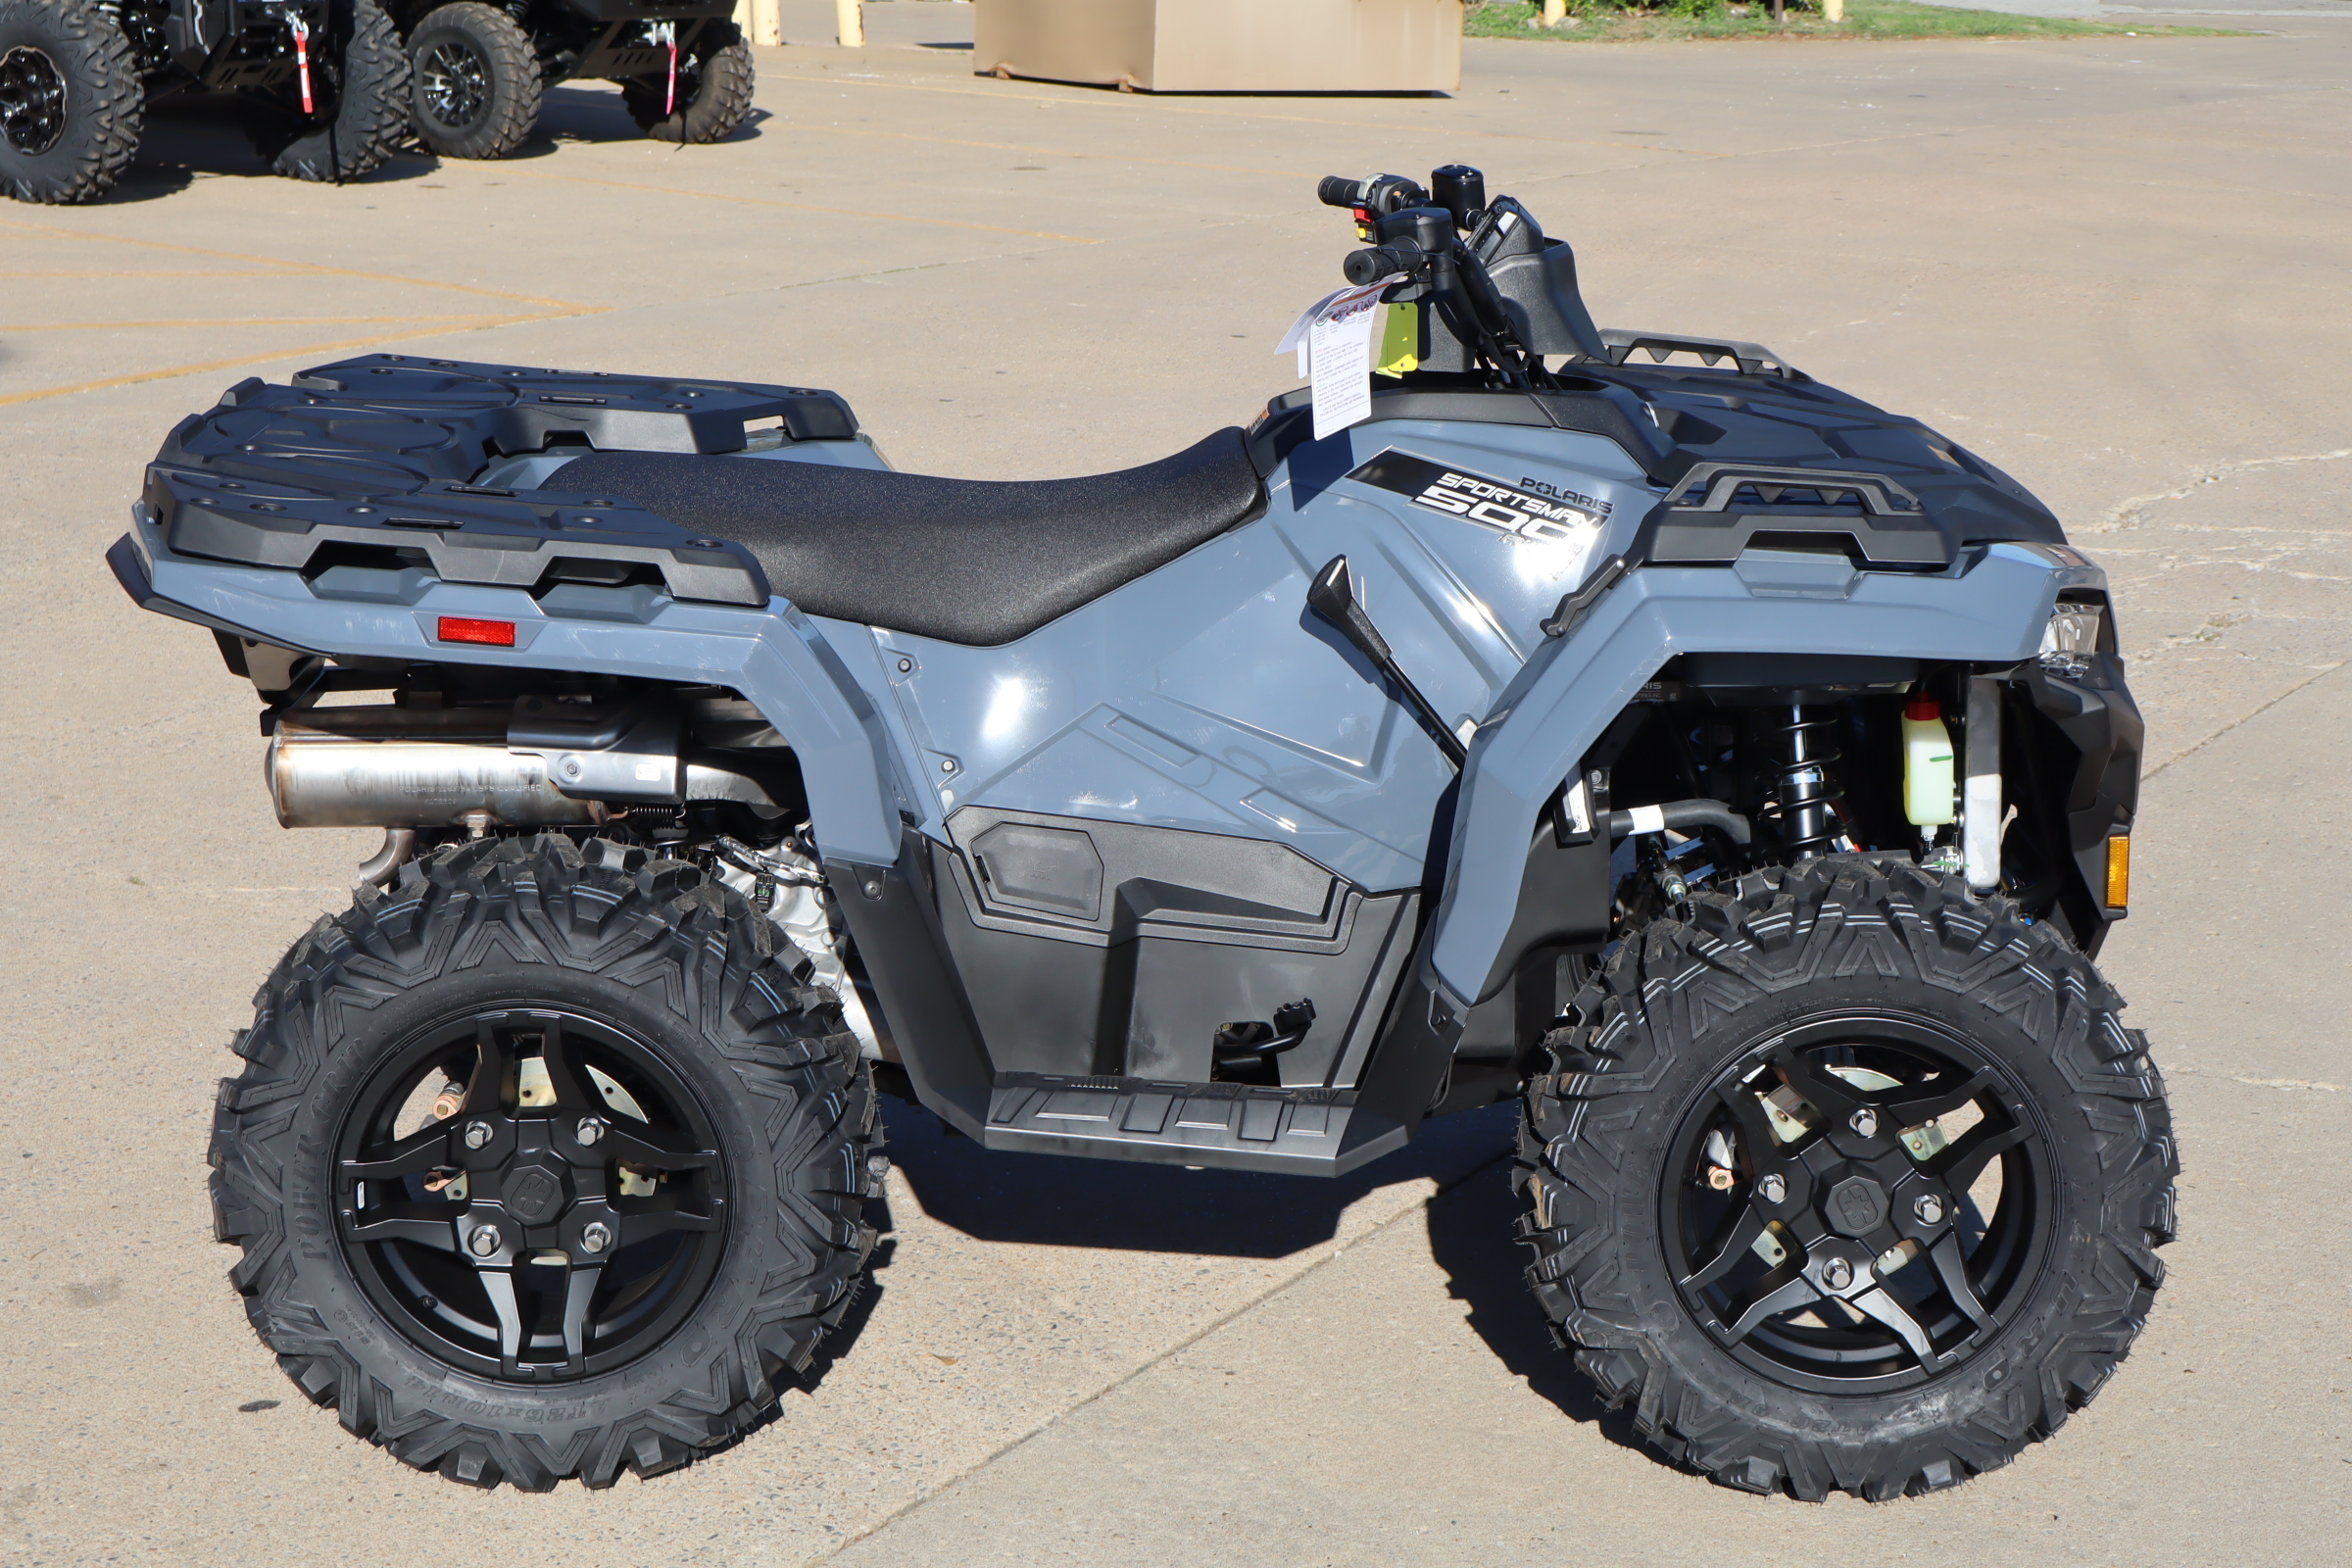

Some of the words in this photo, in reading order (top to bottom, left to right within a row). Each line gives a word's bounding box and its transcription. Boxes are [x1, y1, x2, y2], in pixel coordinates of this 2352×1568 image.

[1414, 484, 1590, 548] 500
[1436, 471, 1598, 529] SPORTSMAN
[1520, 475, 1615, 515] POLARIS
[497, 784, 543, 793] QUALIFIED
[310, 1037, 367, 1123] GRIP
[293, 1133, 330, 1261] POWER
[680, 1179, 768, 1368] DURO
[1982, 1220, 2088, 1392] DURO
